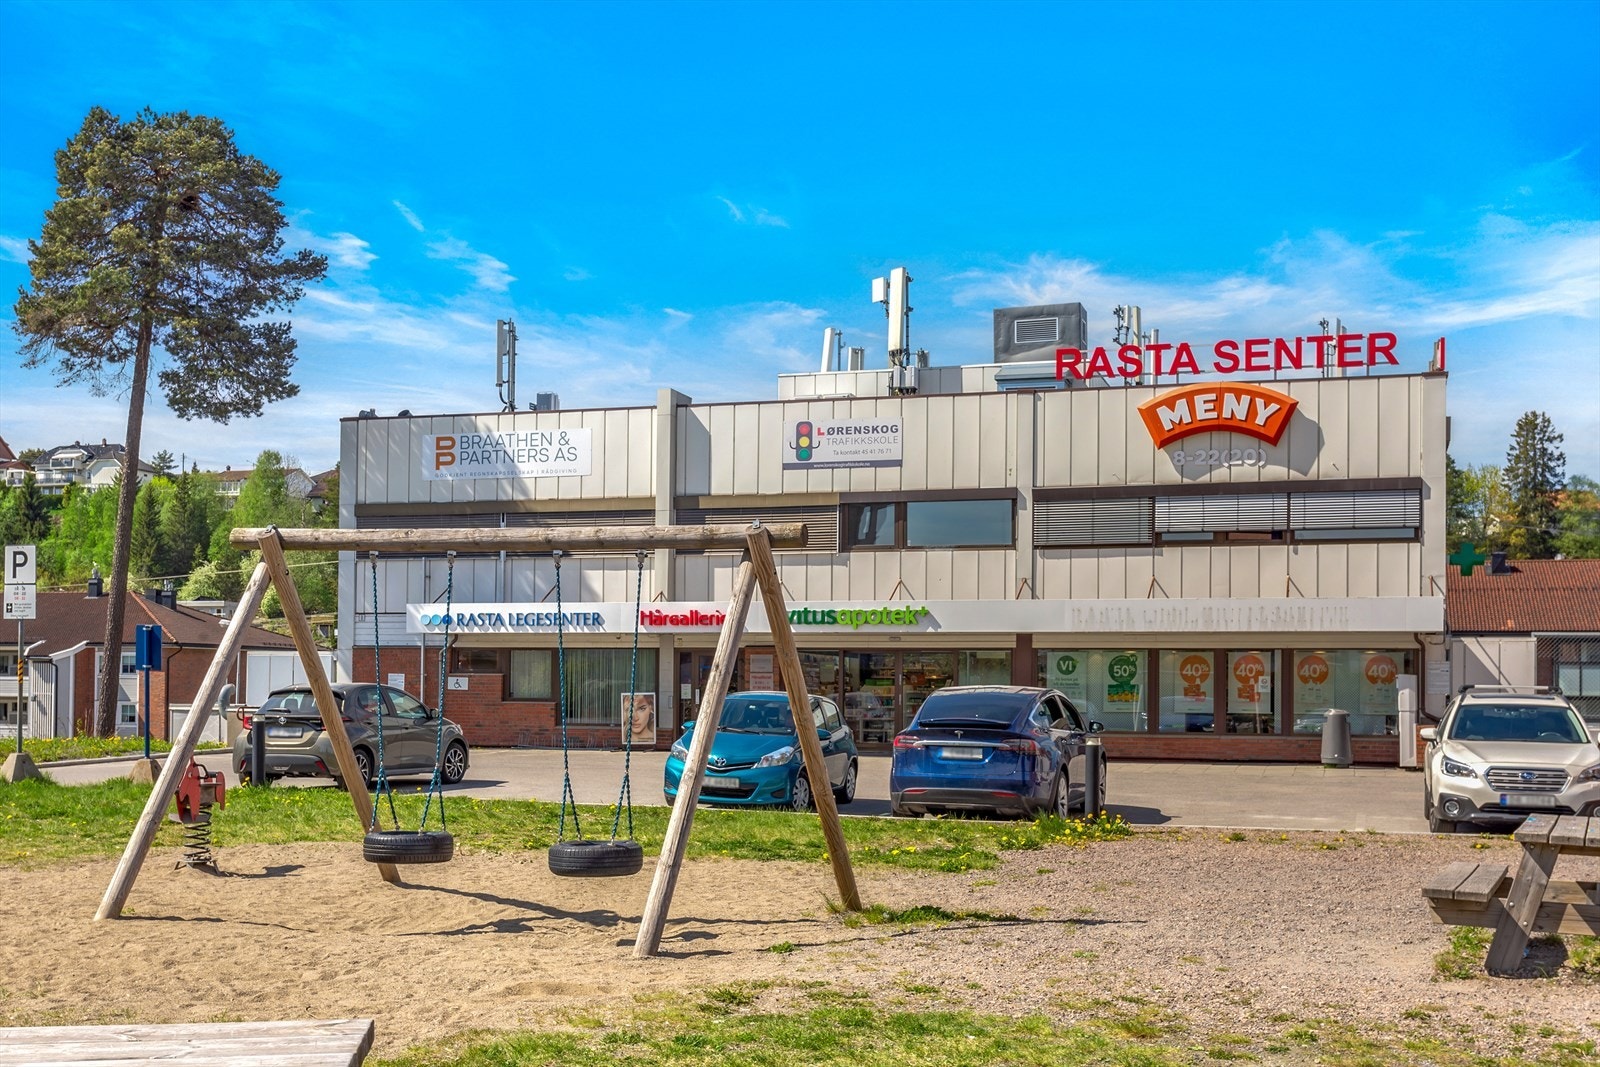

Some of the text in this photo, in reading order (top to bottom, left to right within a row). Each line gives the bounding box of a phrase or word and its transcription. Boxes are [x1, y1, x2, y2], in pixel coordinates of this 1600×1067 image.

[1056, 332, 1399, 380] RASTA SENTER
[1156, 393, 1280, 431] MENY
[817, 425, 898, 436] LØRENSKOG
[460, 431, 570, 450] BRAATHEN &
[826, 436, 898, 446] TRAFIKKSKOLE
[459, 447, 578, 465] PARTNERS AS
[1172, 448, 1267, 467] 8-22(20)
[12, 551, 28, 578] P
[456, 611, 602, 627] RASTA LEGESENTER
[1060, 660, 1072, 671] VI
[1113, 665, 1136, 677] 50%
[1182, 664, 1209, 677] 40%
[1236, 664, 1263, 677] 40%
[1300, 664, 1328, 677] 40%
[1367, 664, 1396, 678] 40%
